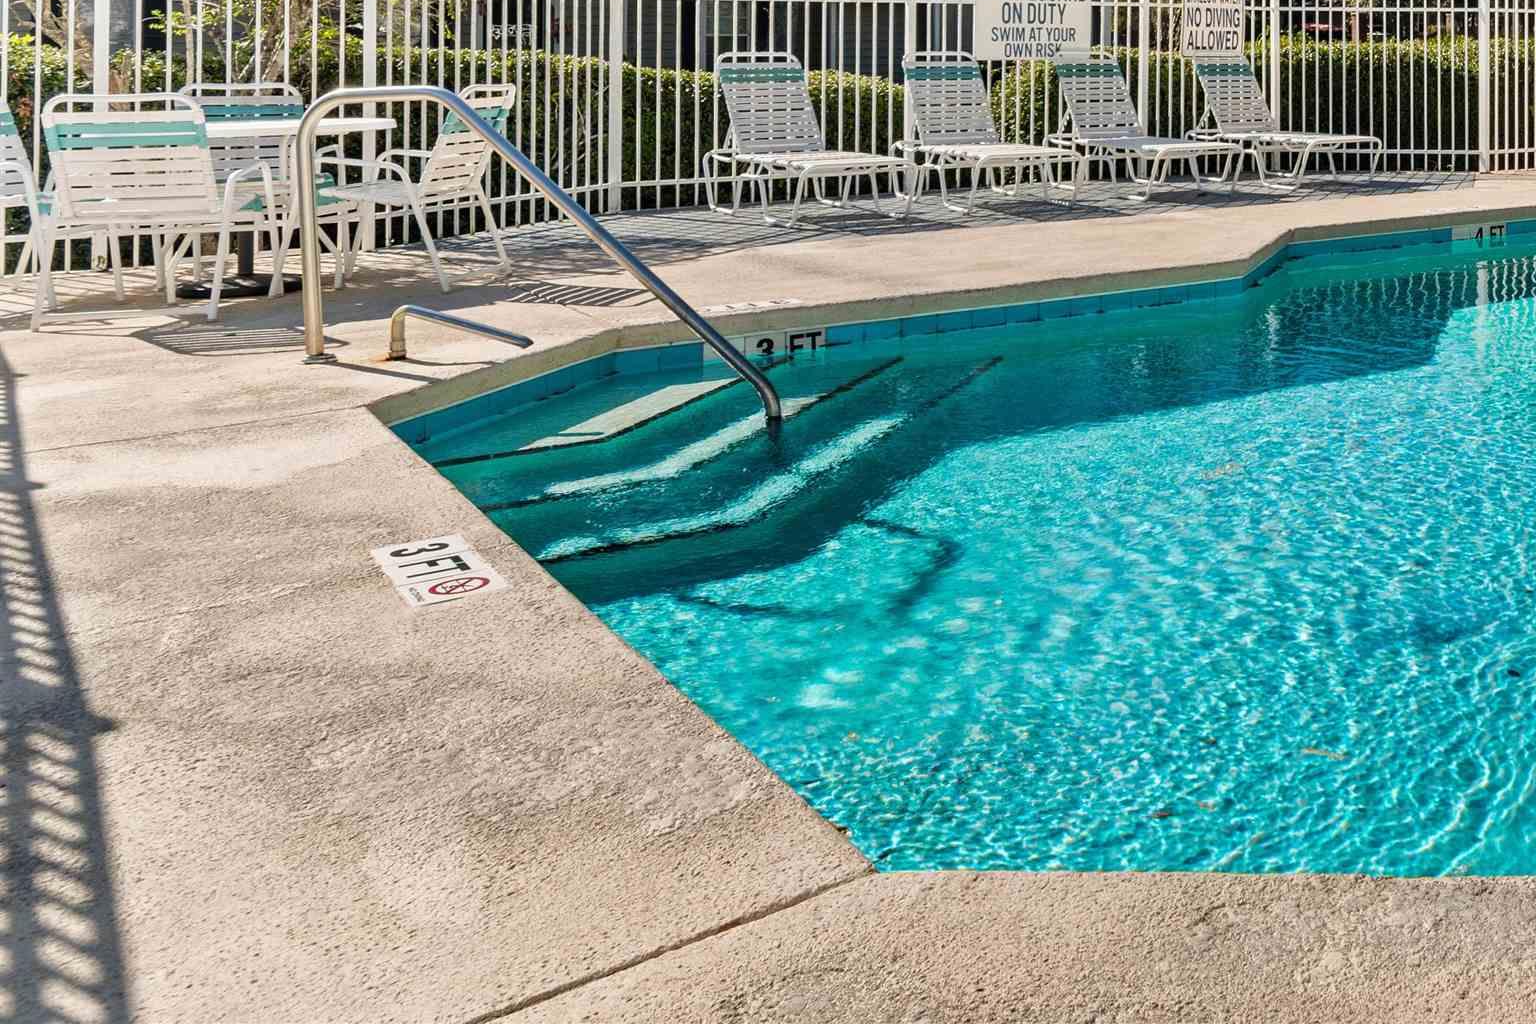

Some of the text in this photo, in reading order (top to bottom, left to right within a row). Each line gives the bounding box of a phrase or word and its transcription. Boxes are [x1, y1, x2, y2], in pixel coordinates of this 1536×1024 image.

[1002, 2, 1067, 25] ON DUTY
[1186, 7, 1240, 28] NO DIVING
[991, 27, 1077, 42] SWIM AT YOUR
[1186, 30, 1239, 51] ALLOWED
[1004, 43, 1033, 57] OWN
[1489, 224, 1505, 238] FT
[789, 331, 822, 353] FT
[389, 542, 472, 579] 3 FT
